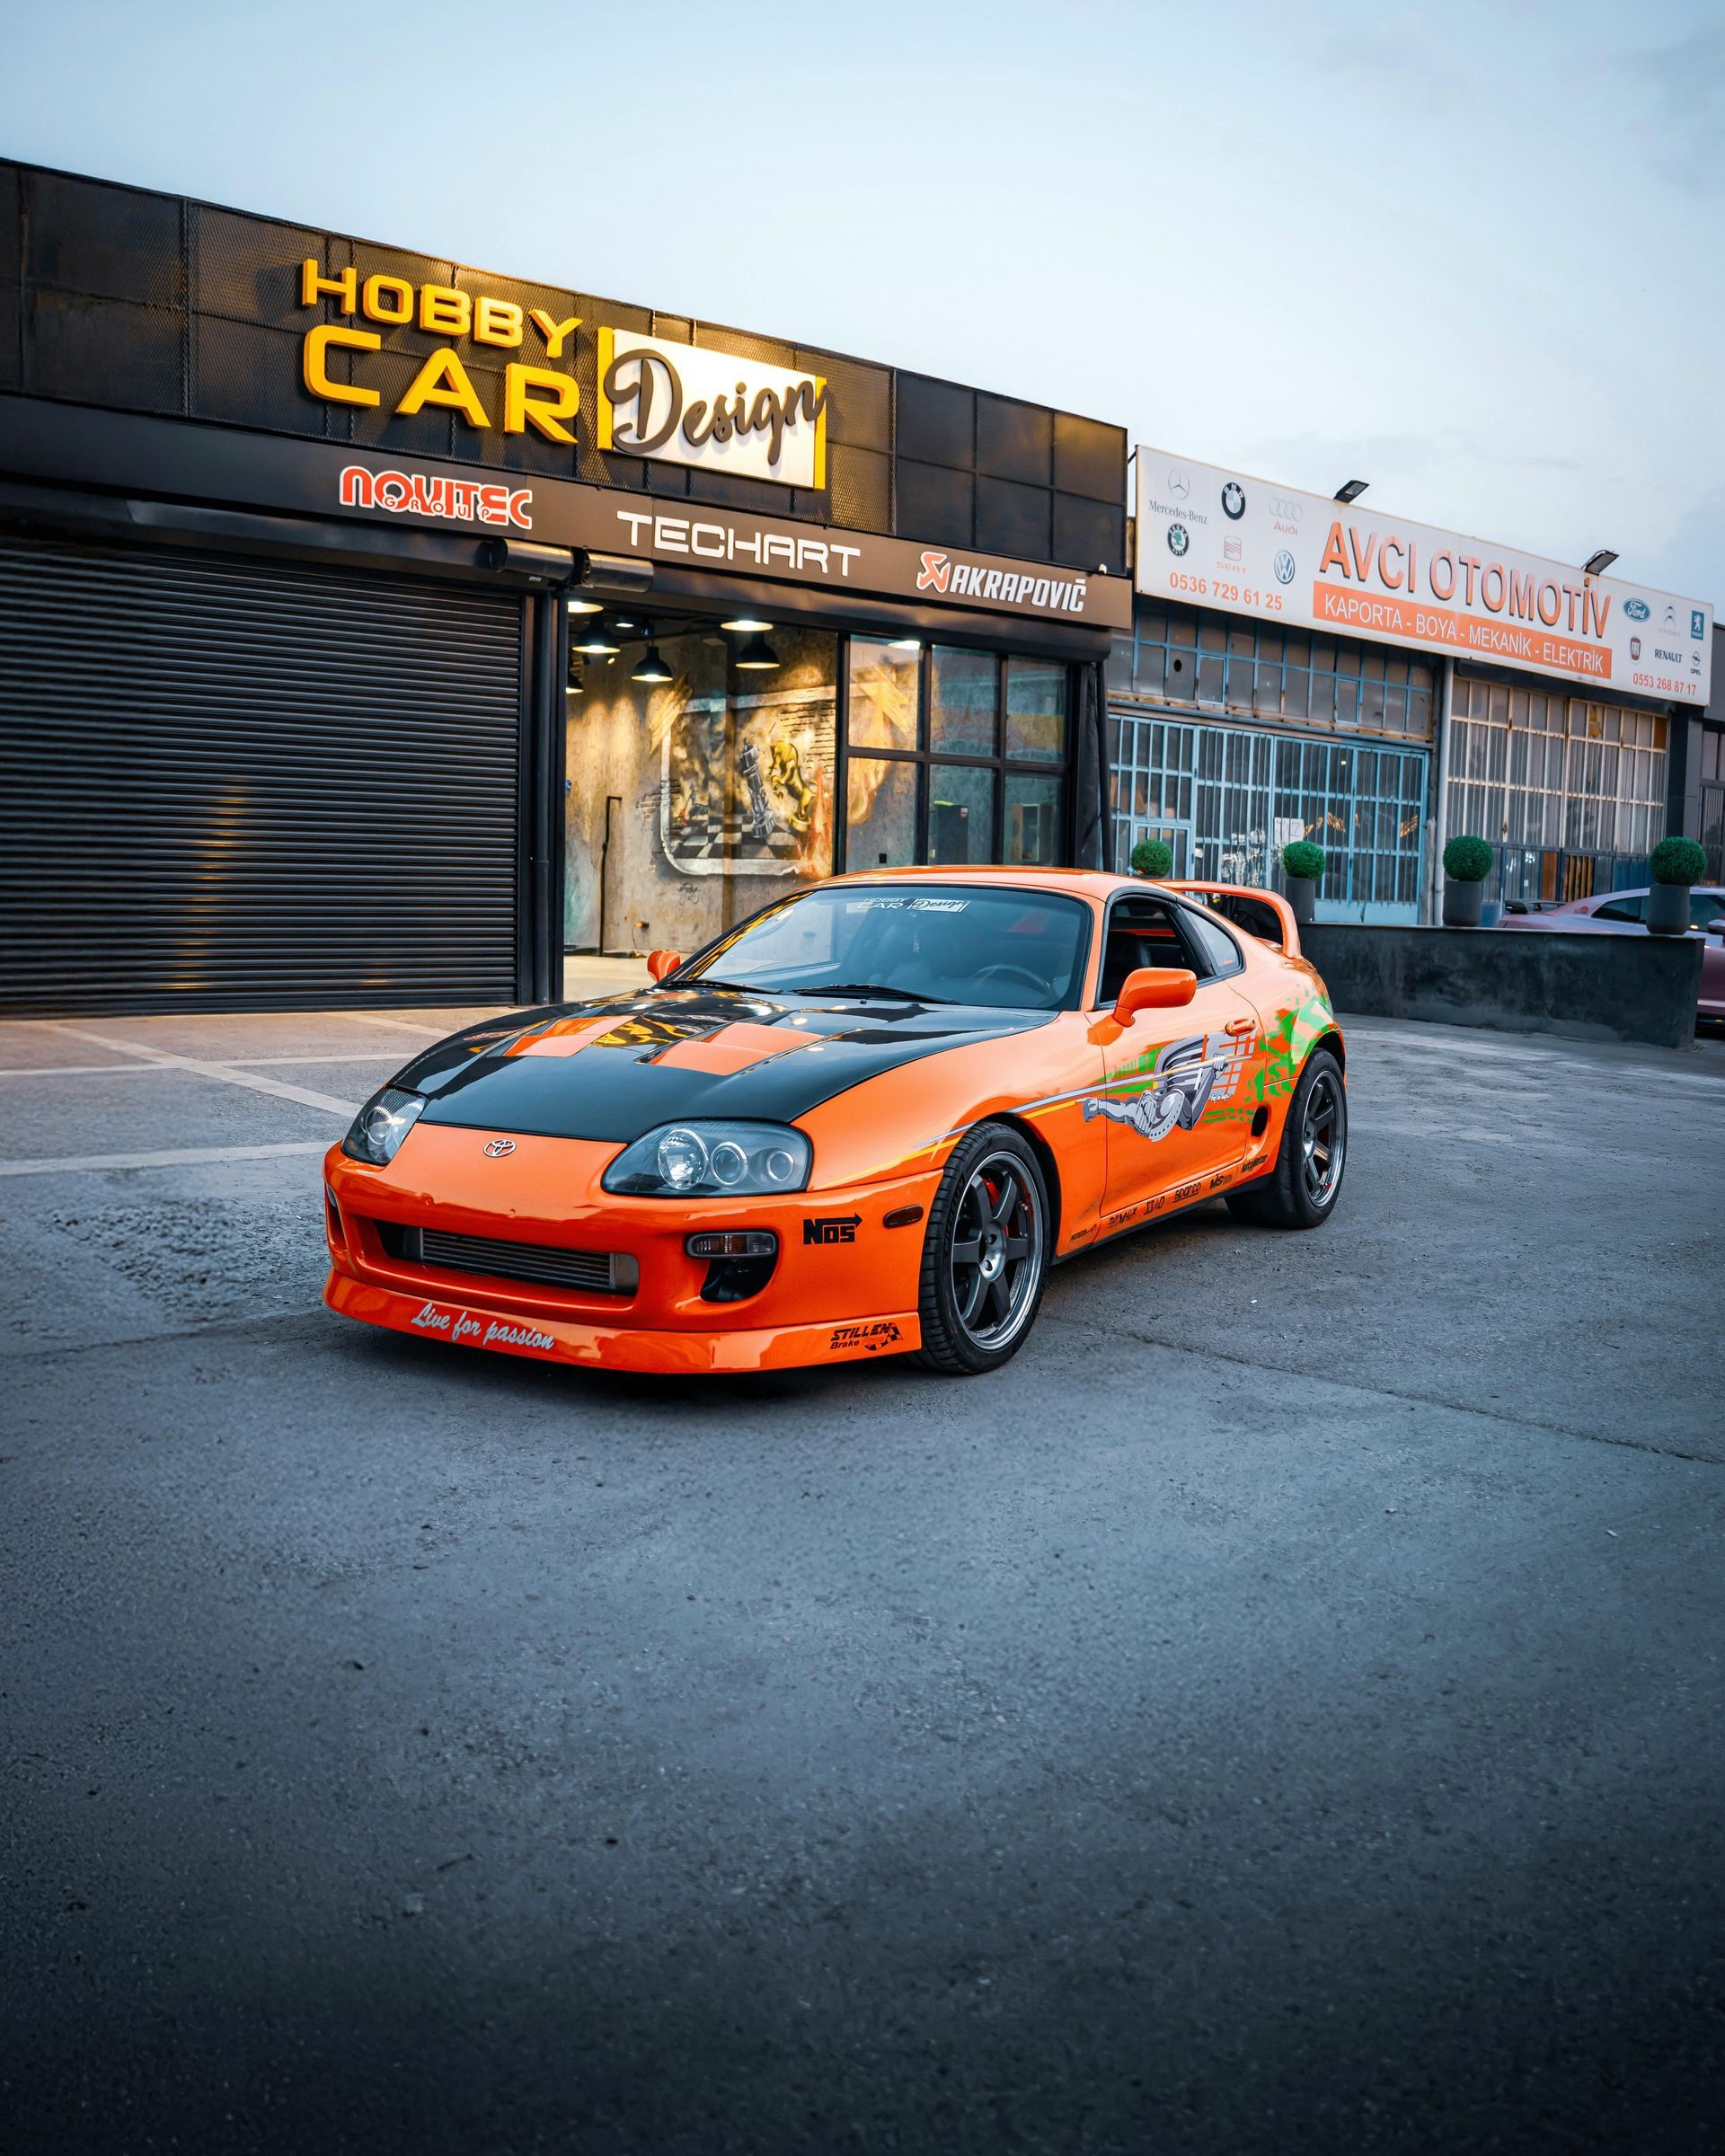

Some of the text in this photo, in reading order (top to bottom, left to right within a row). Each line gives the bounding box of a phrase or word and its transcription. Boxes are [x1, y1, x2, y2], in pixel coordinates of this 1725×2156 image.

[302, 258, 583, 358] HOBBY
[303, 324, 579, 445] CAR
[604, 349, 827, 465] Design
[340, 466, 532, 529] NOVITEC
[1224, 482, 1244, 498] BMW
[384, 495, 491, 520] GROUP
[1149, 500, 1208, 525] Mercedes-Benz
[1274, 521, 1298, 535] Audi
[616, 511, 861, 577] TECHART
[1216, 561, 1247, 574] SEAT
[1319, 521, 1611, 639] AVCI OTOMOTİV
[1170, 572, 1283, 610] 0536 729 61 25
[1627, 601, 1646, 619] Ford
[1325, 593, 1603, 673] KAPORTA BOYA MEKANİK ELEKTRİK
[1654, 649, 1682, 663] RENAULT
[1633, 672, 1696, 695] 0553 268 87 17
[915, 898, 966, 909] Design
[803, 1215, 859, 1244] NOS
[411, 1303, 554, 1349] Live for passion
[831, 1322, 893, 1341] STILLEN
[830, 1340, 860, 1349] Brake
